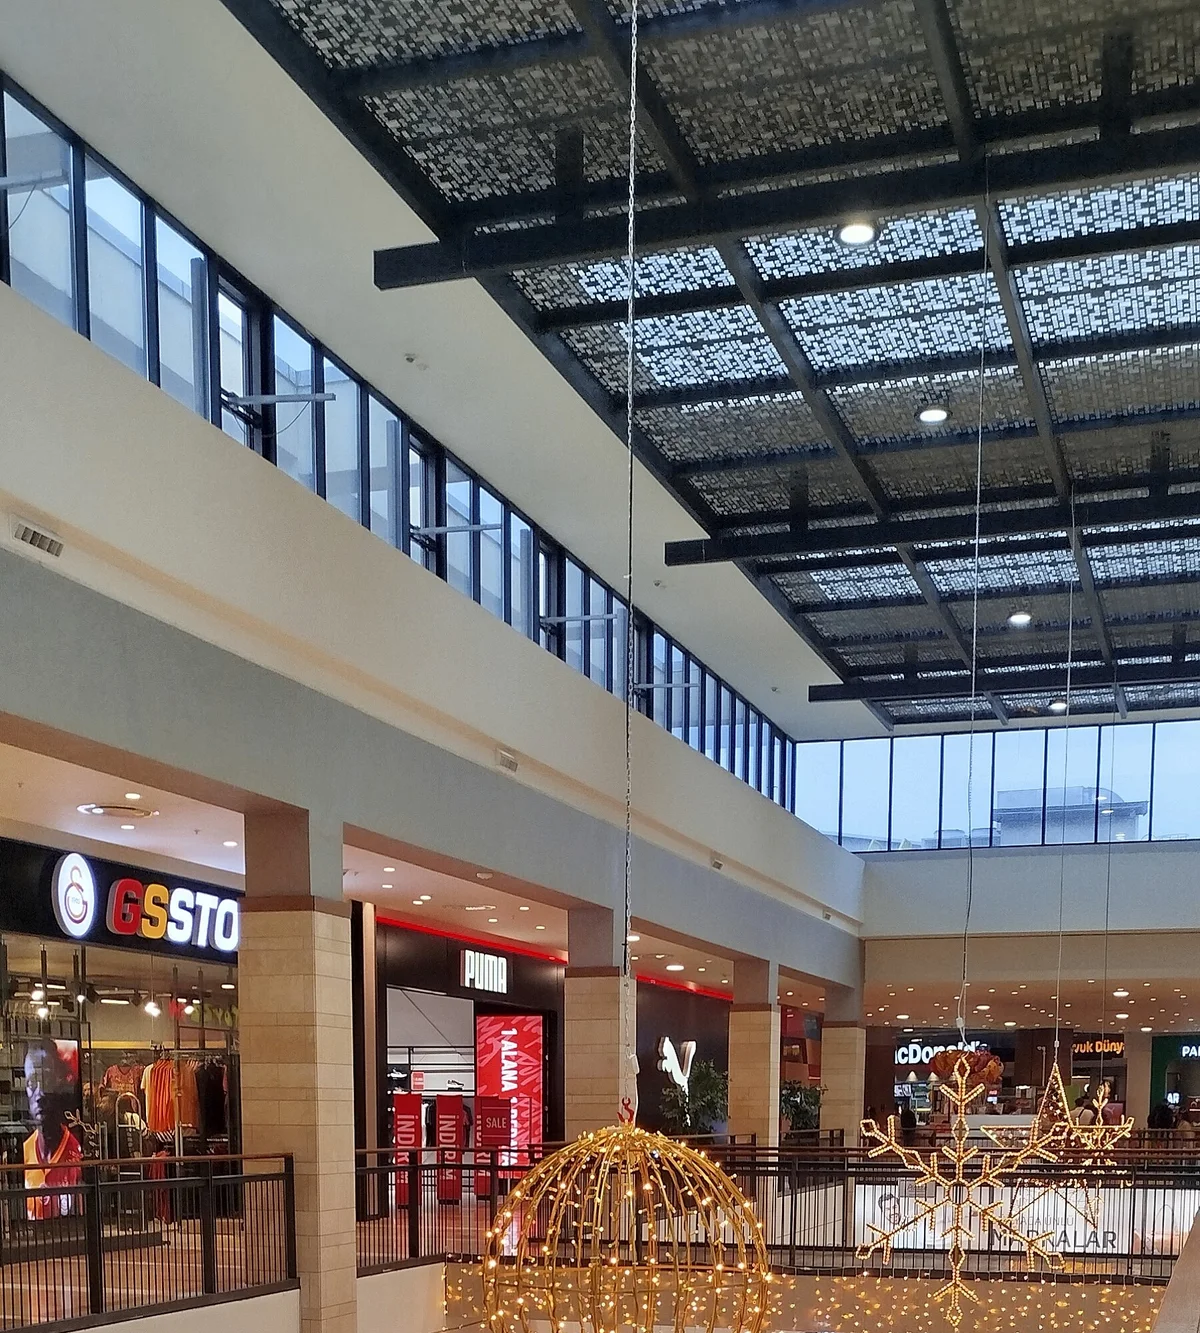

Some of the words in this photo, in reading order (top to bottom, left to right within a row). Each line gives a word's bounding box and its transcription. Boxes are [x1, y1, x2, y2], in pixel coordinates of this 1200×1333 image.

[464, 949, 508, 994] PUMA
[501, 1039, 518, 1092] ALANA
[486, 1117, 507, 1129] SALE
